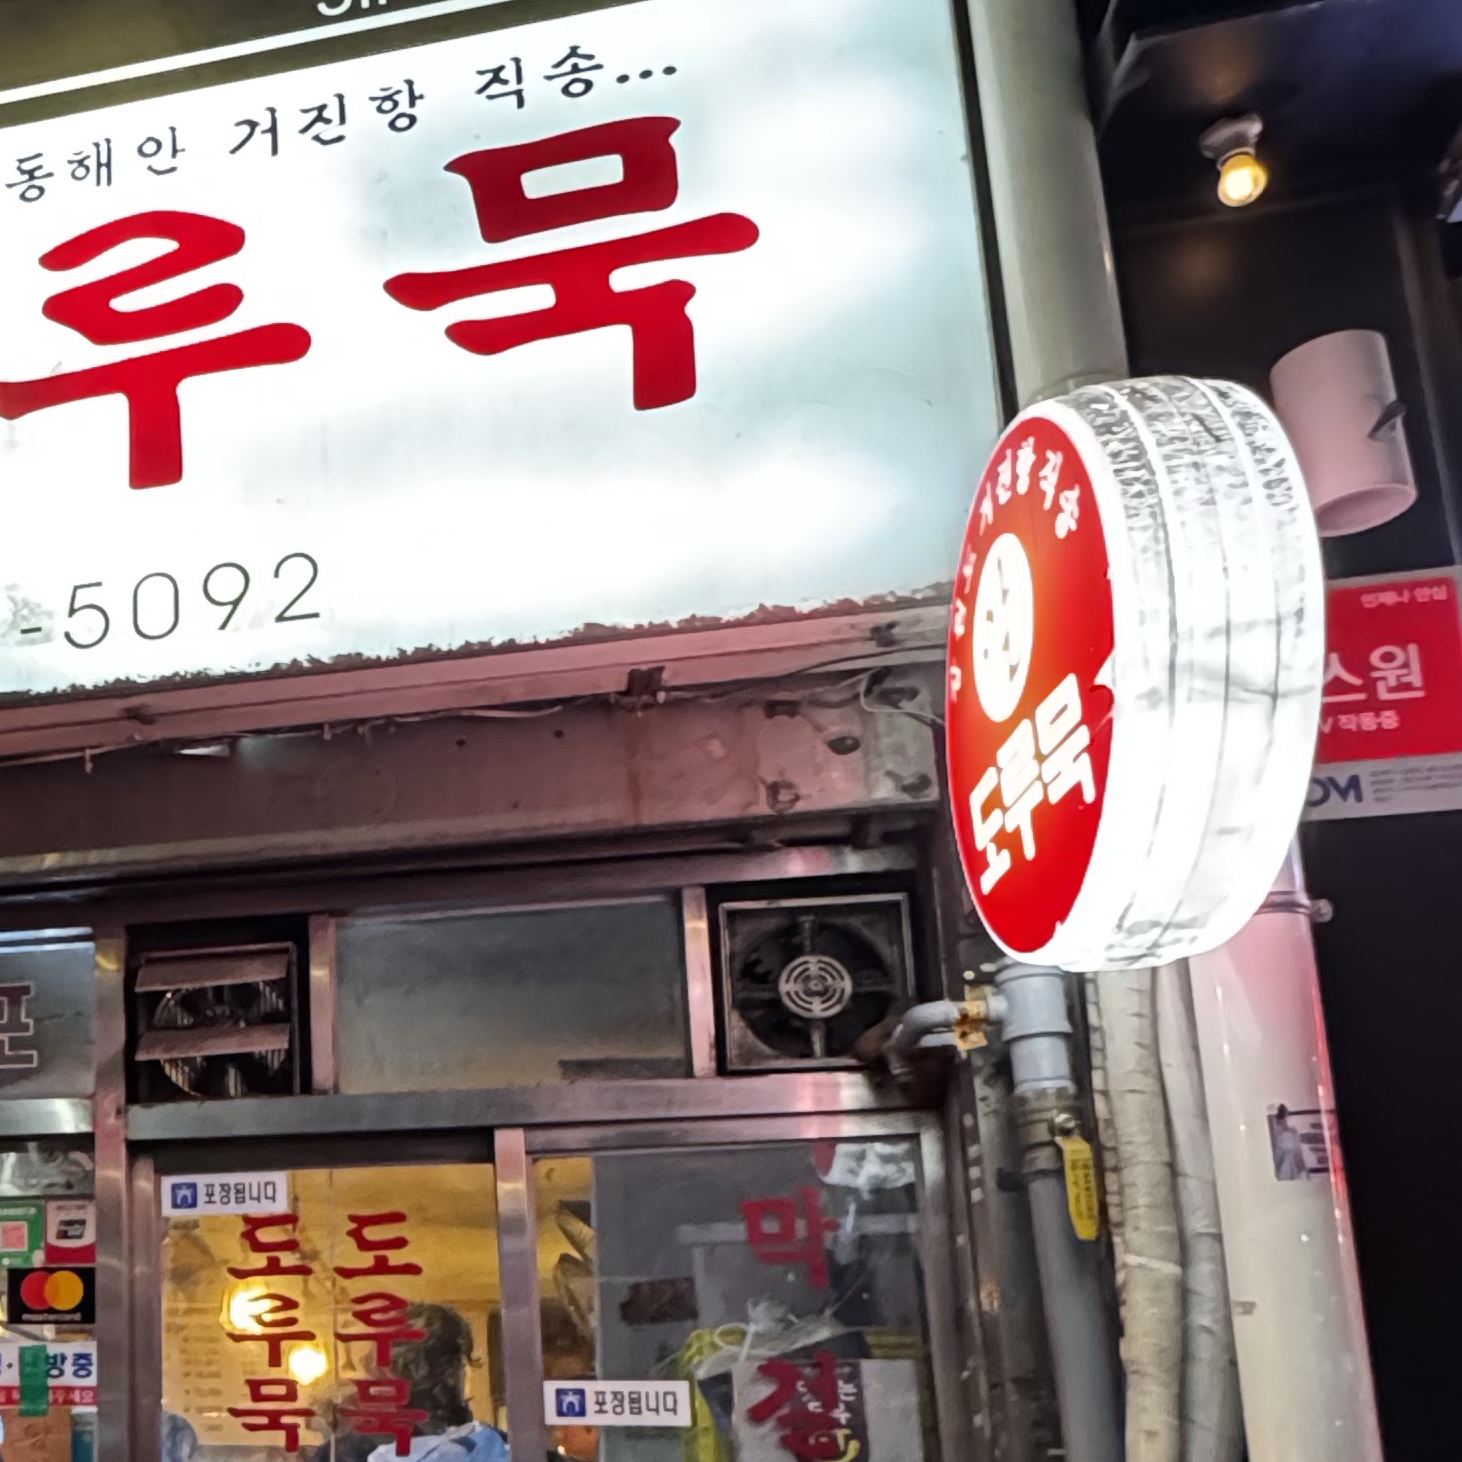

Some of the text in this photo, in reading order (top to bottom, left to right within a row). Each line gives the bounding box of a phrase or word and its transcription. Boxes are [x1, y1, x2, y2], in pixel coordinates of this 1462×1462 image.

[5, 126, 186, 203] 동해안
[229, 79, 425, 157] 거진항
[1323, 642, 1426, 702] 스원
[969, 672, 1097, 895] 도루묵
[203, 1180, 277, 1206] 포장됩니다
[593, 1389, 678, 1416] 포장됩니다
